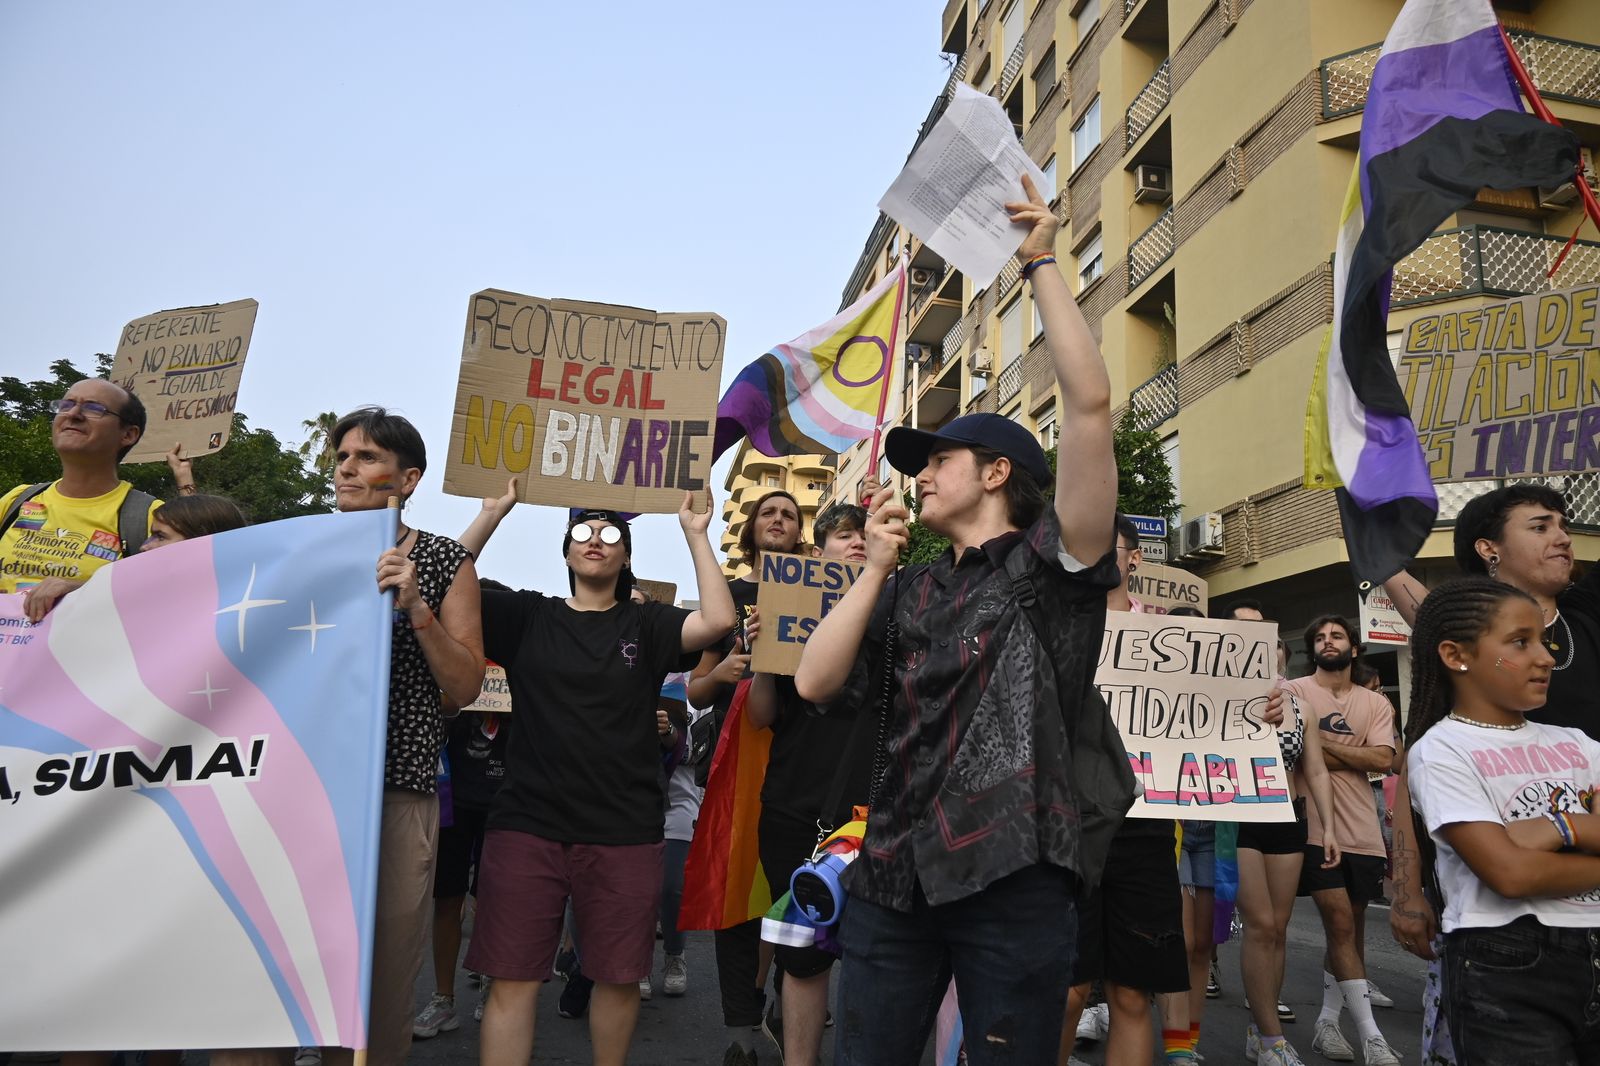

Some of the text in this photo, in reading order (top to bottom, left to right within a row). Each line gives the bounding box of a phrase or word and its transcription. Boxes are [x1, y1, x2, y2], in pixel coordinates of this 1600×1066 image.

[122, 312, 225, 346] REFERENTE
[471, 295, 721, 371] RECONOCIMIENTO
[1405, 288, 1599, 353] BASTA DE
[140, 335, 242, 374] NO BINARIO
[526, 358, 665, 410] LEGAL
[461, 395, 709, 490] NO BINARIE
[1130, 520, 1163, 532] VILLA
[1139, 545, 1163, 555] tales
[1128, 574, 1200, 603] ONTERAS
[1096, 684, 1216, 739] TIDAD
[1222, 696, 1274, 742] ES
[33, 739, 265, 797] SUMA!
